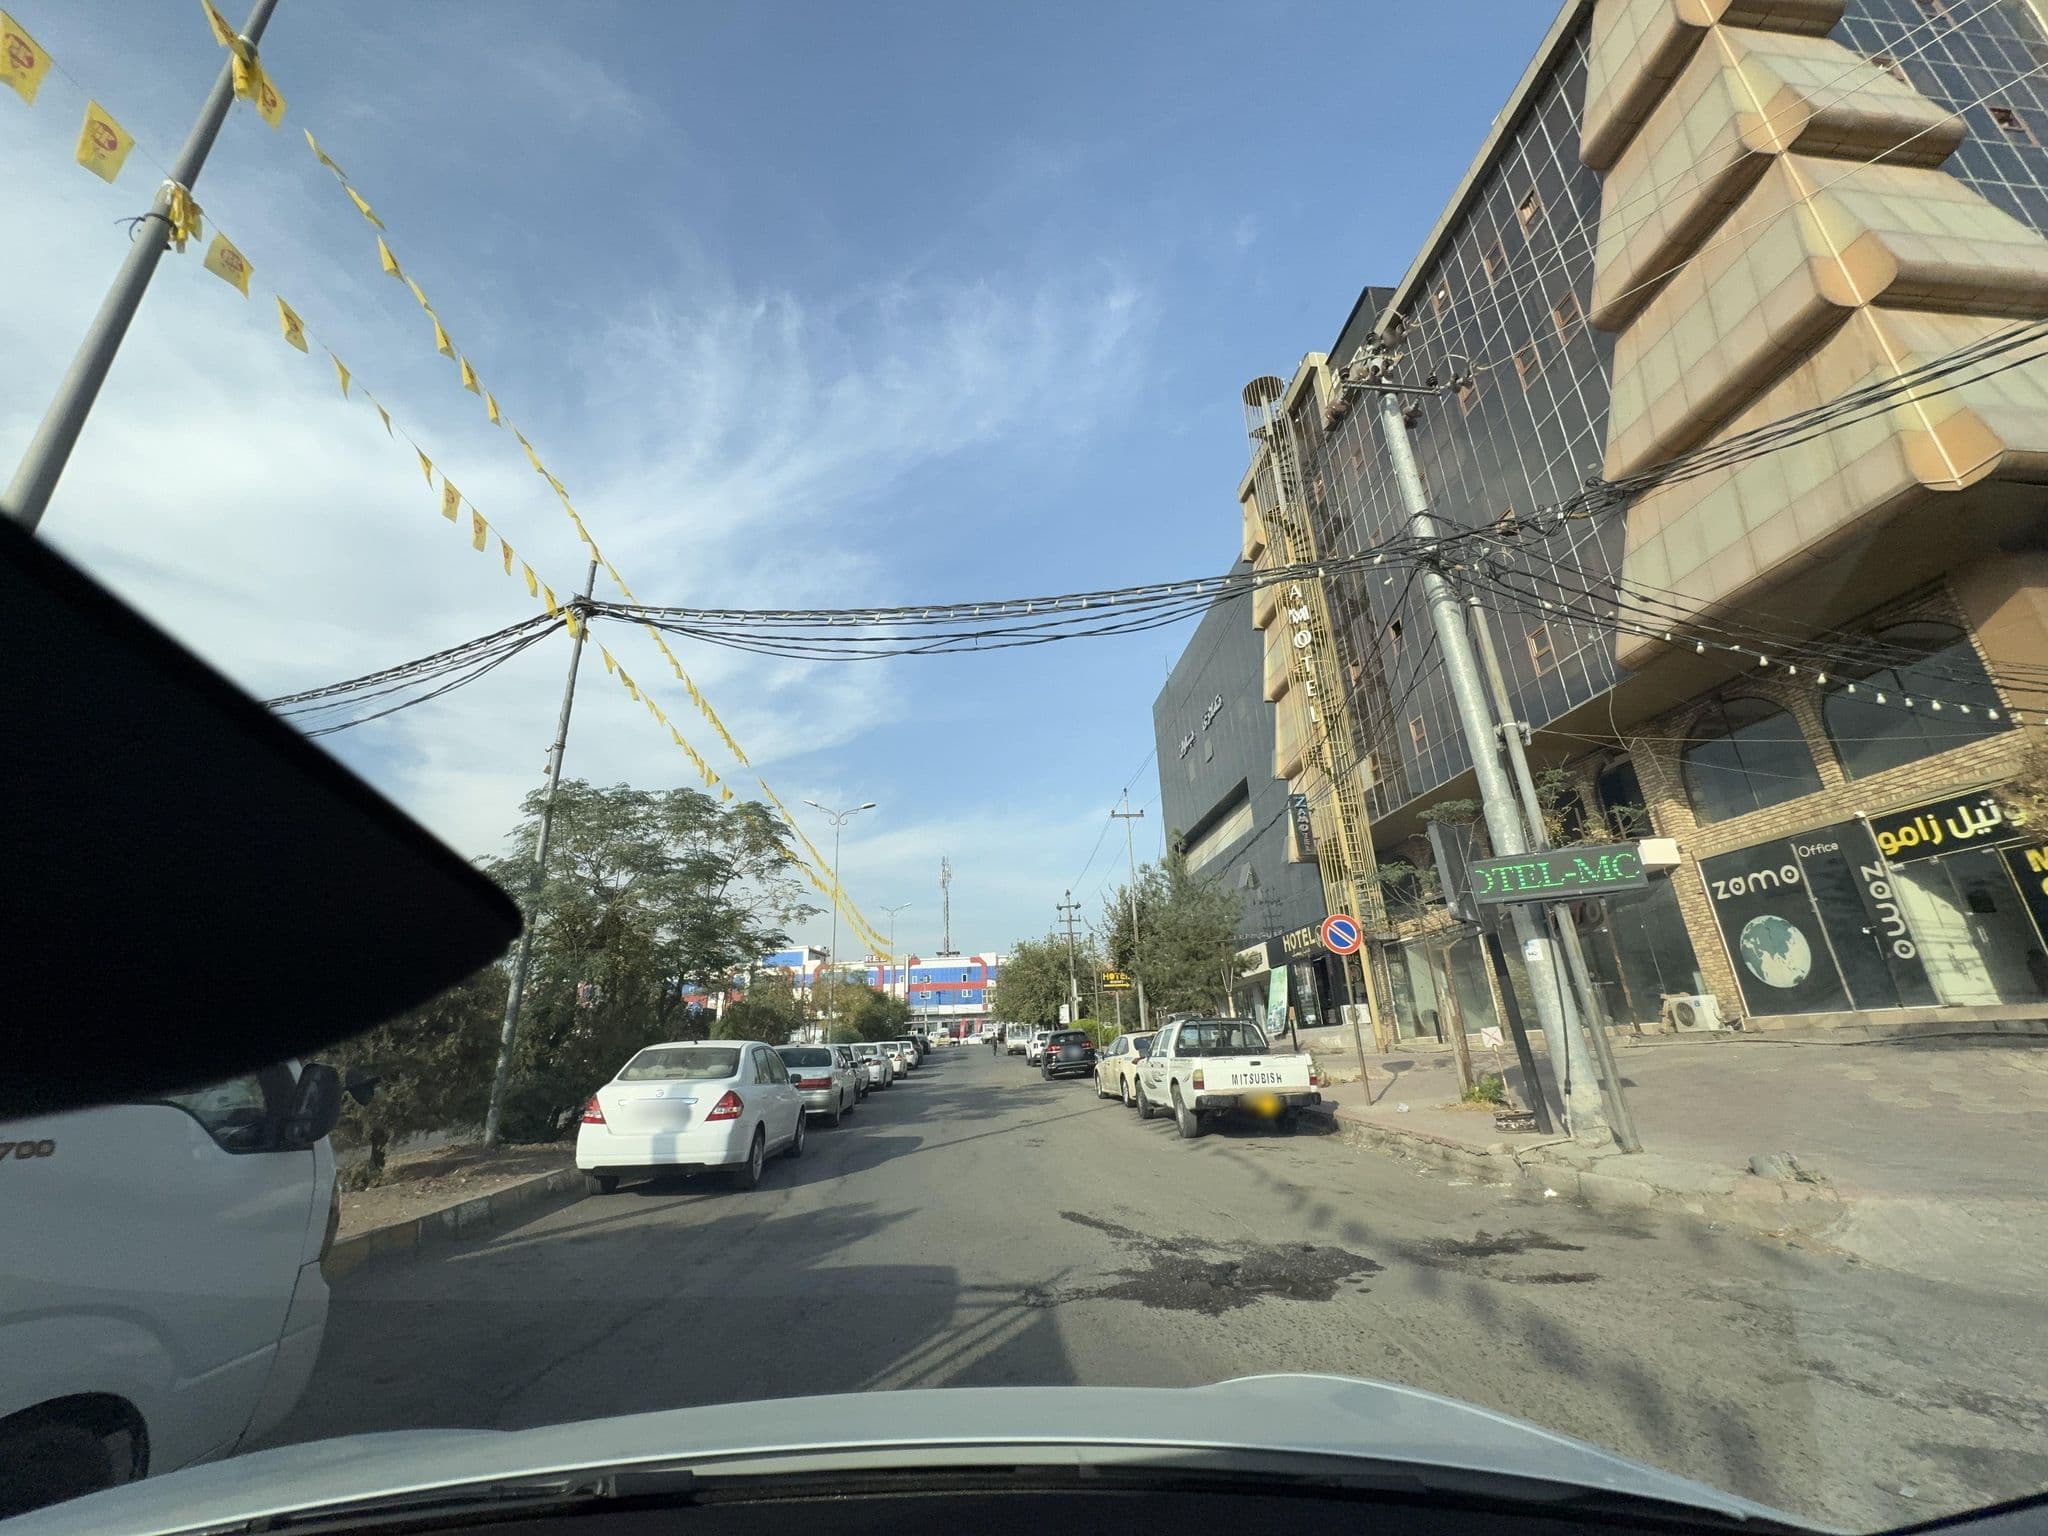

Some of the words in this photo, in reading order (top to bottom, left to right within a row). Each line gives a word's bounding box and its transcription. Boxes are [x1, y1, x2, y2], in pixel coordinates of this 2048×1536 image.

[1877, 813, 1943, 855] زامو
[1798, 842, 1839, 858] Office
[1711, 864, 1800, 900] zamo
[1860, 860, 1916, 960] zamo
[1282, 926, 1316, 953] HOTEL
[1231, 1072, 1282, 1086] MITSUBISH
